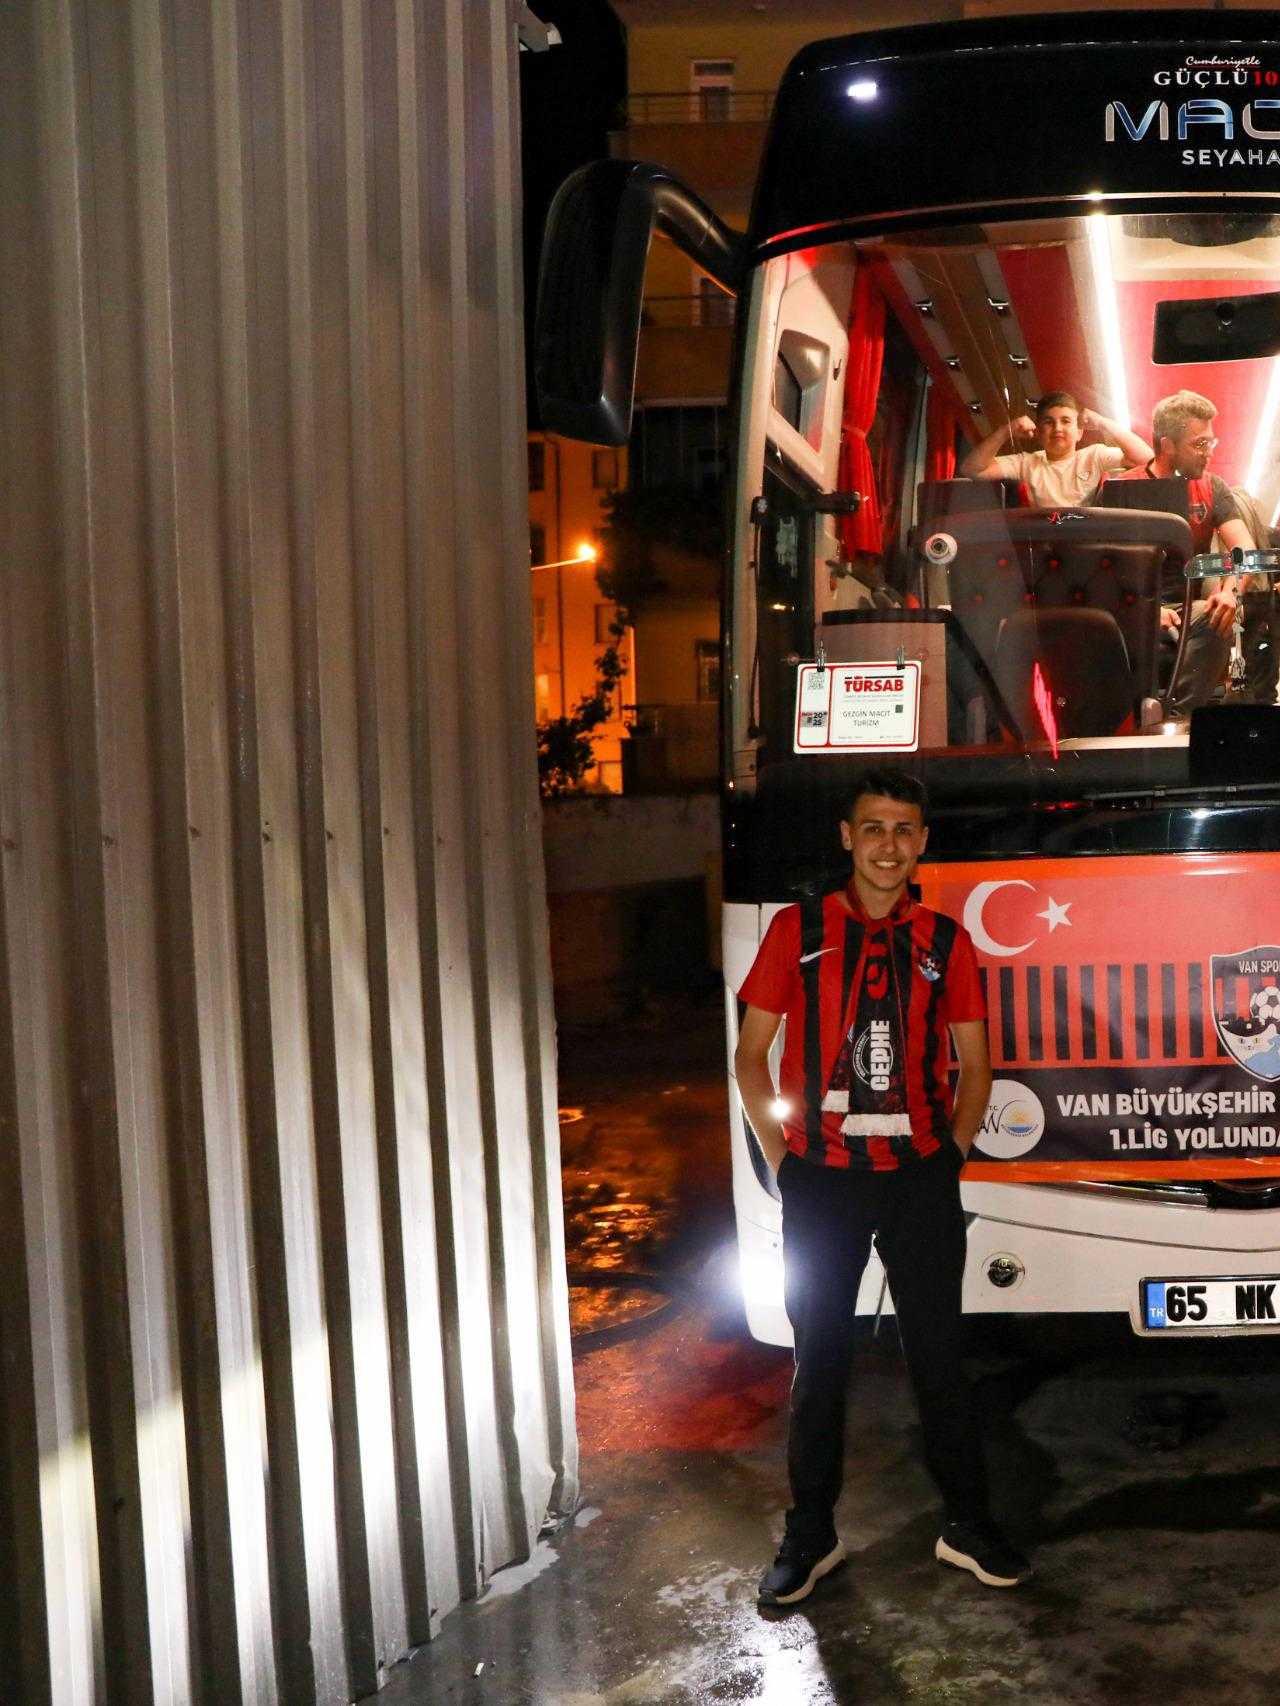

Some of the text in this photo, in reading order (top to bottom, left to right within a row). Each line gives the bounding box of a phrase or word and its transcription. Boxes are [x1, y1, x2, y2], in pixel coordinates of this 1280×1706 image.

[1153, 68, 1248, 88] GÜÇLÜ
[844, 678, 904, 692] TÜRSAB
[1239, 959, 1258, 973] VAN
[870, 1020, 890, 1091] CEPHE
[1057, 1092, 1110, 1117] VAN
[1115, 1085, 1276, 1119] BÜYÜKŞEHİR
[1150, 1307, 1165, 1318] TR
[1166, 1285, 1208, 1322] 65
[1236, 1284, 1276, 1320] NK
